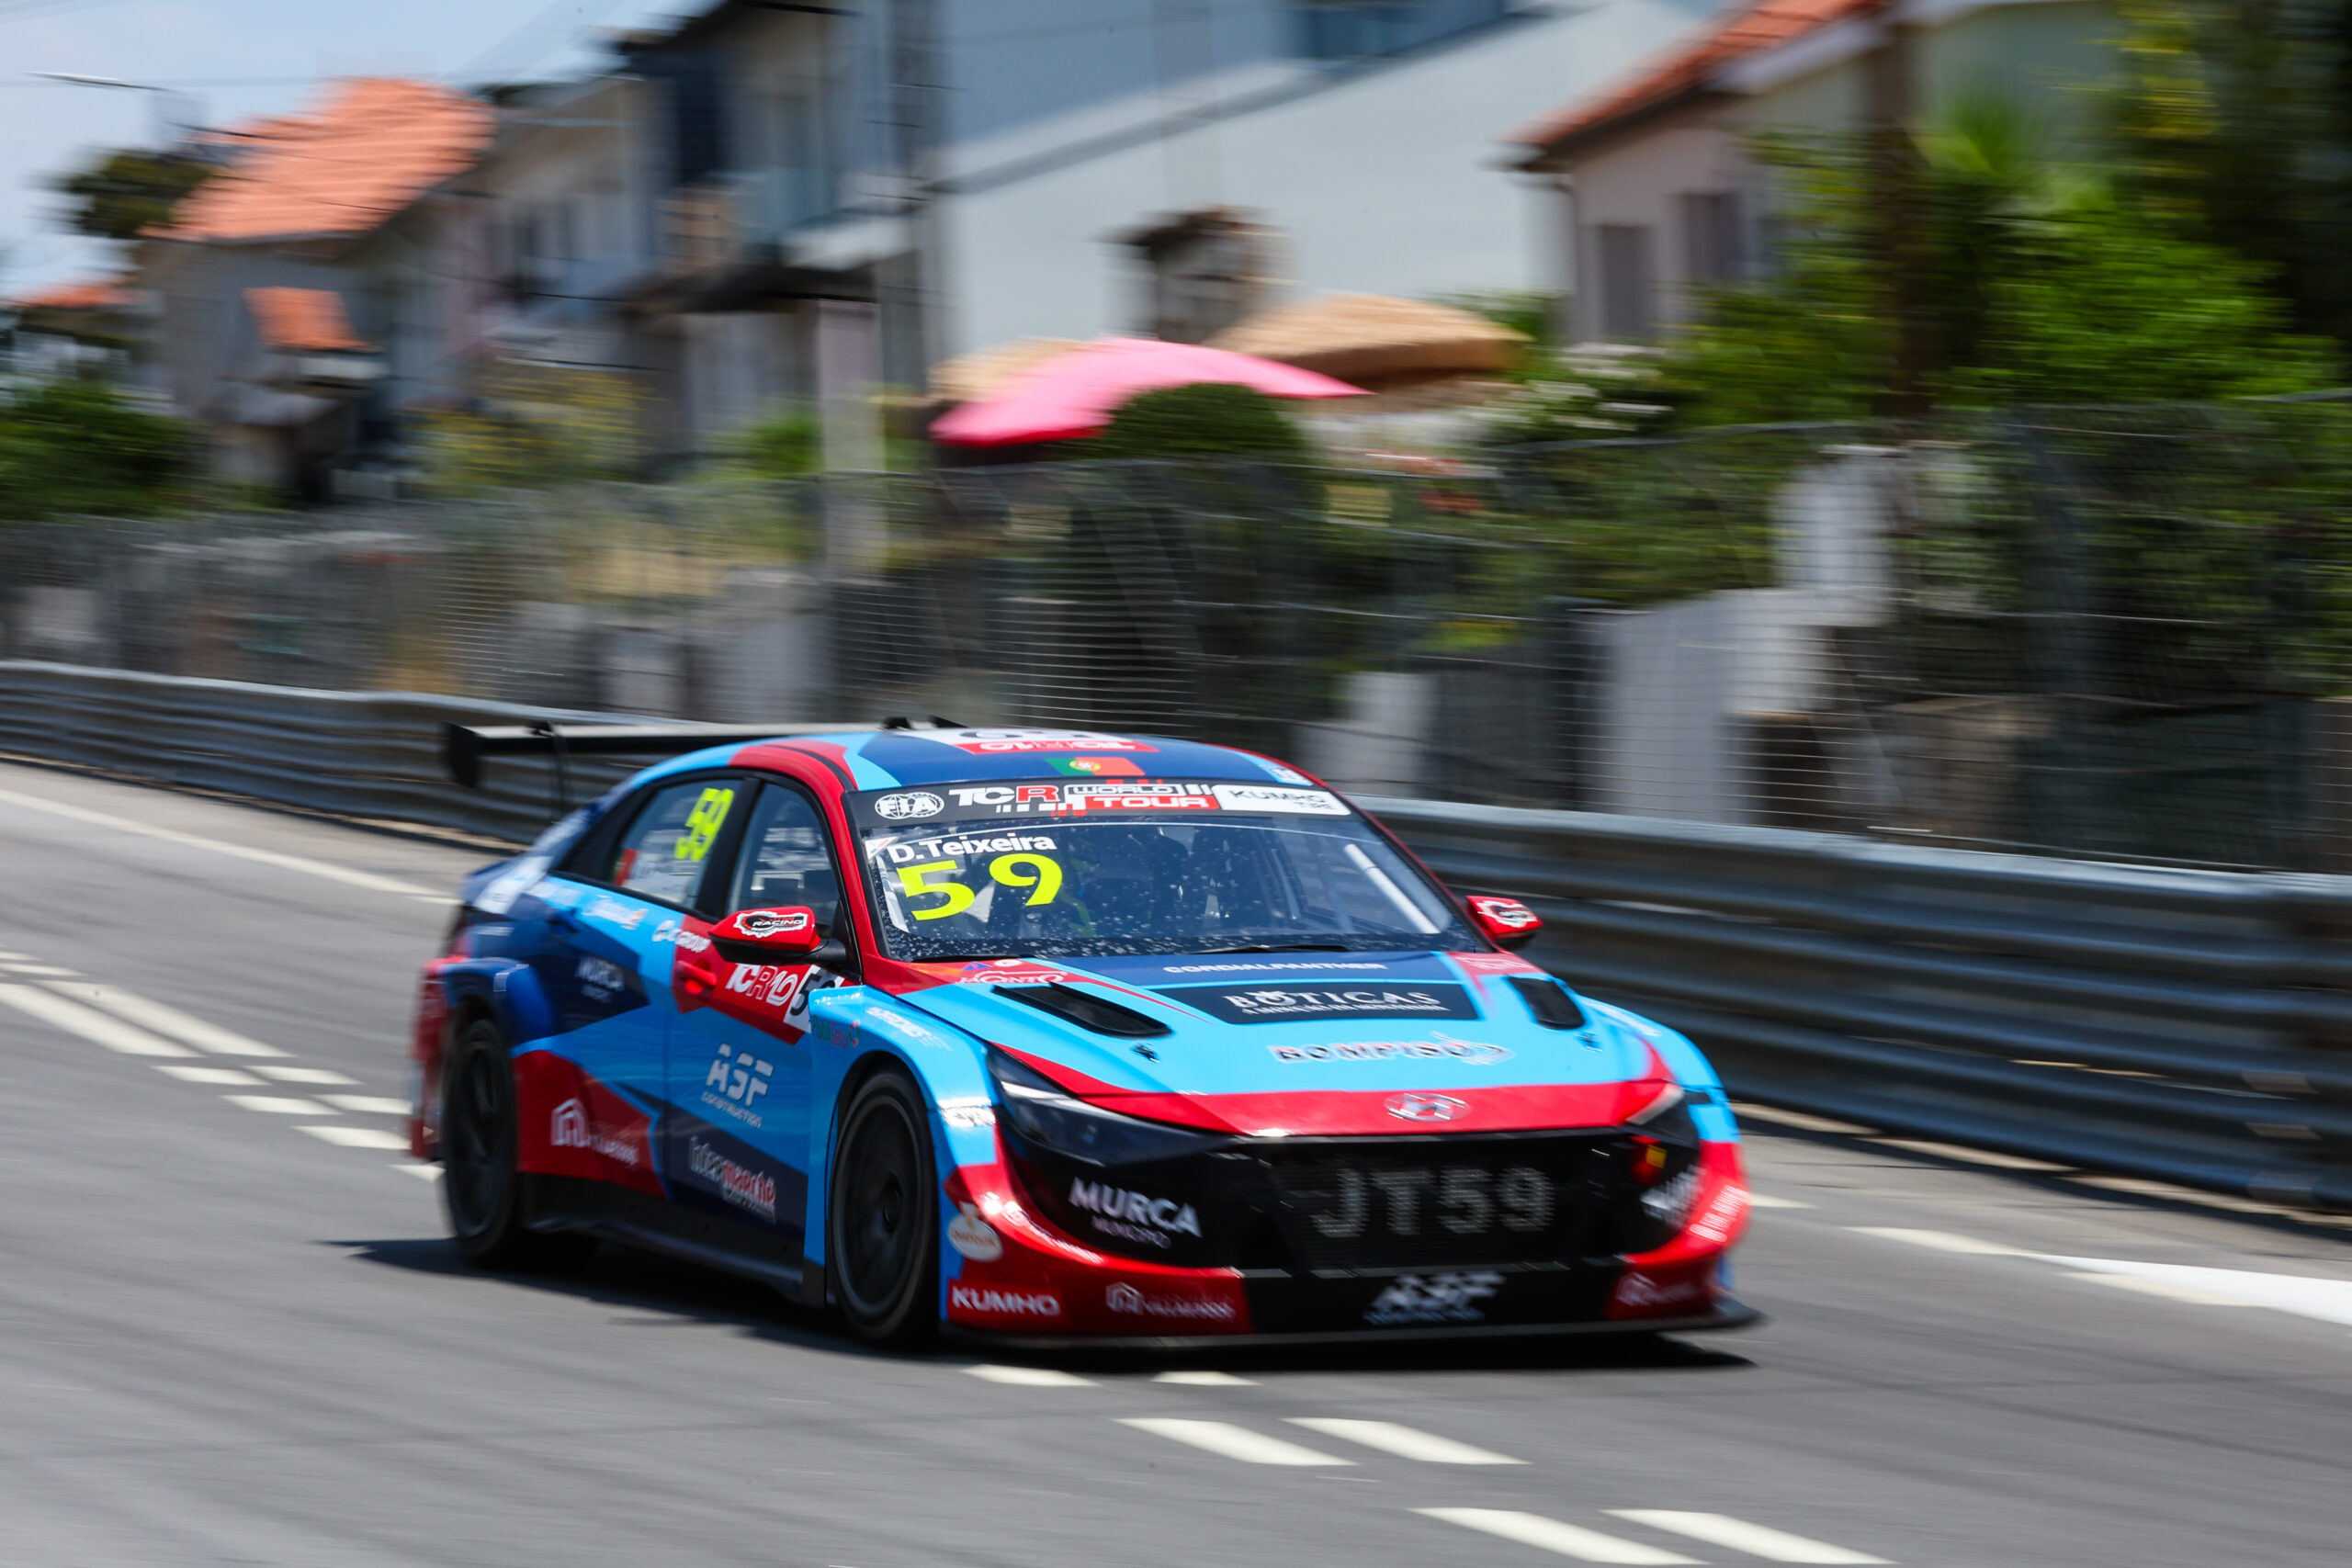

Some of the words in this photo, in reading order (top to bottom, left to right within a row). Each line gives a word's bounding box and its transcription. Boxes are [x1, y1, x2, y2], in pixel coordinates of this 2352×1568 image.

[949, 784, 1059, 807] TCR
[1072, 786, 1173, 795] WORLD
[1093, 796, 1210, 808] TOUR
[877, 795, 933, 815] FIA
[887, 832, 1057, 863] D.Teixeira
[897, 852, 1063, 920] 59
[752, 919, 804, 928] RACING
[1223, 990, 1442, 1009] BOTICAS
[705, 1043, 775, 1108] ASF
[1309, 1167, 1557, 1239] JT59
[951, 1285, 1062, 1318] KUMHO
